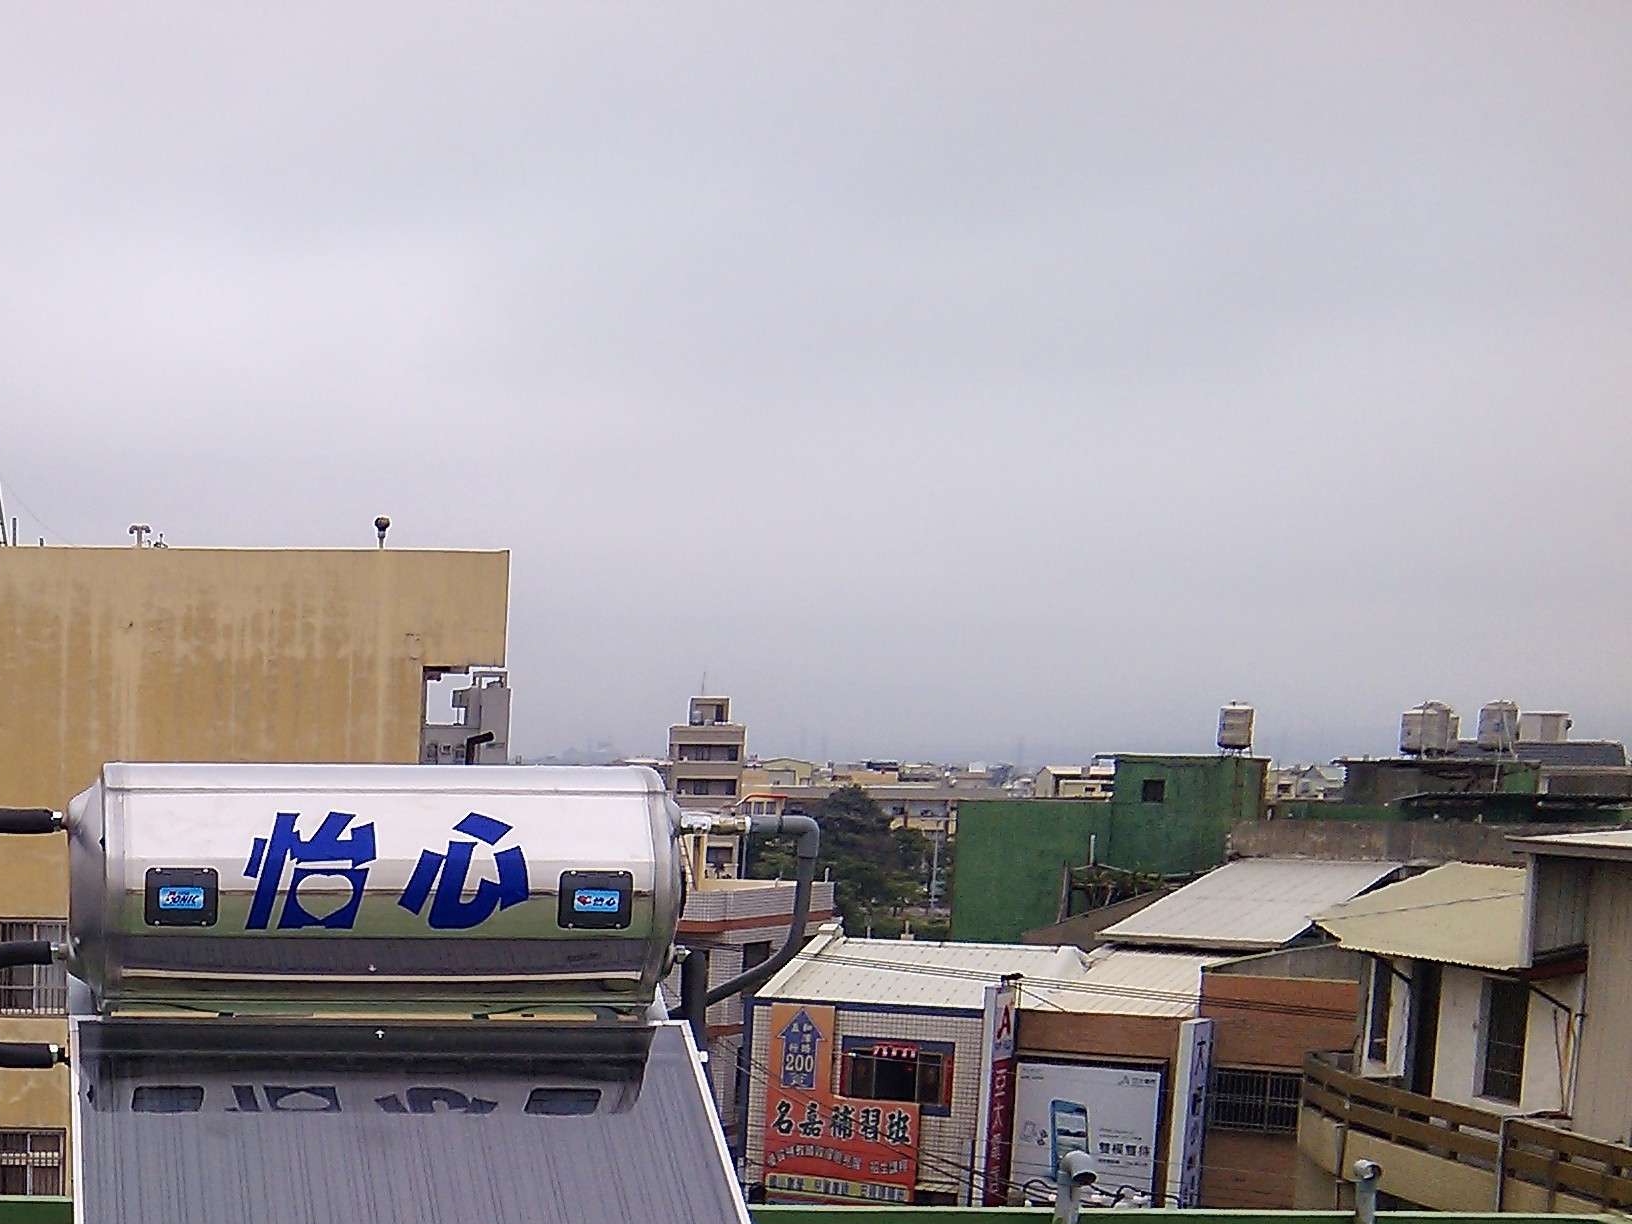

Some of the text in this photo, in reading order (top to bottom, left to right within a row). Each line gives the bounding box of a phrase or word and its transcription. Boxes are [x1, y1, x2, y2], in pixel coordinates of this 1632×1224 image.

[243, 811, 529, 931] 怡心
[785, 1053, 814, 1073] 200
[772, 1099, 913, 1145] 名嘉補習班
